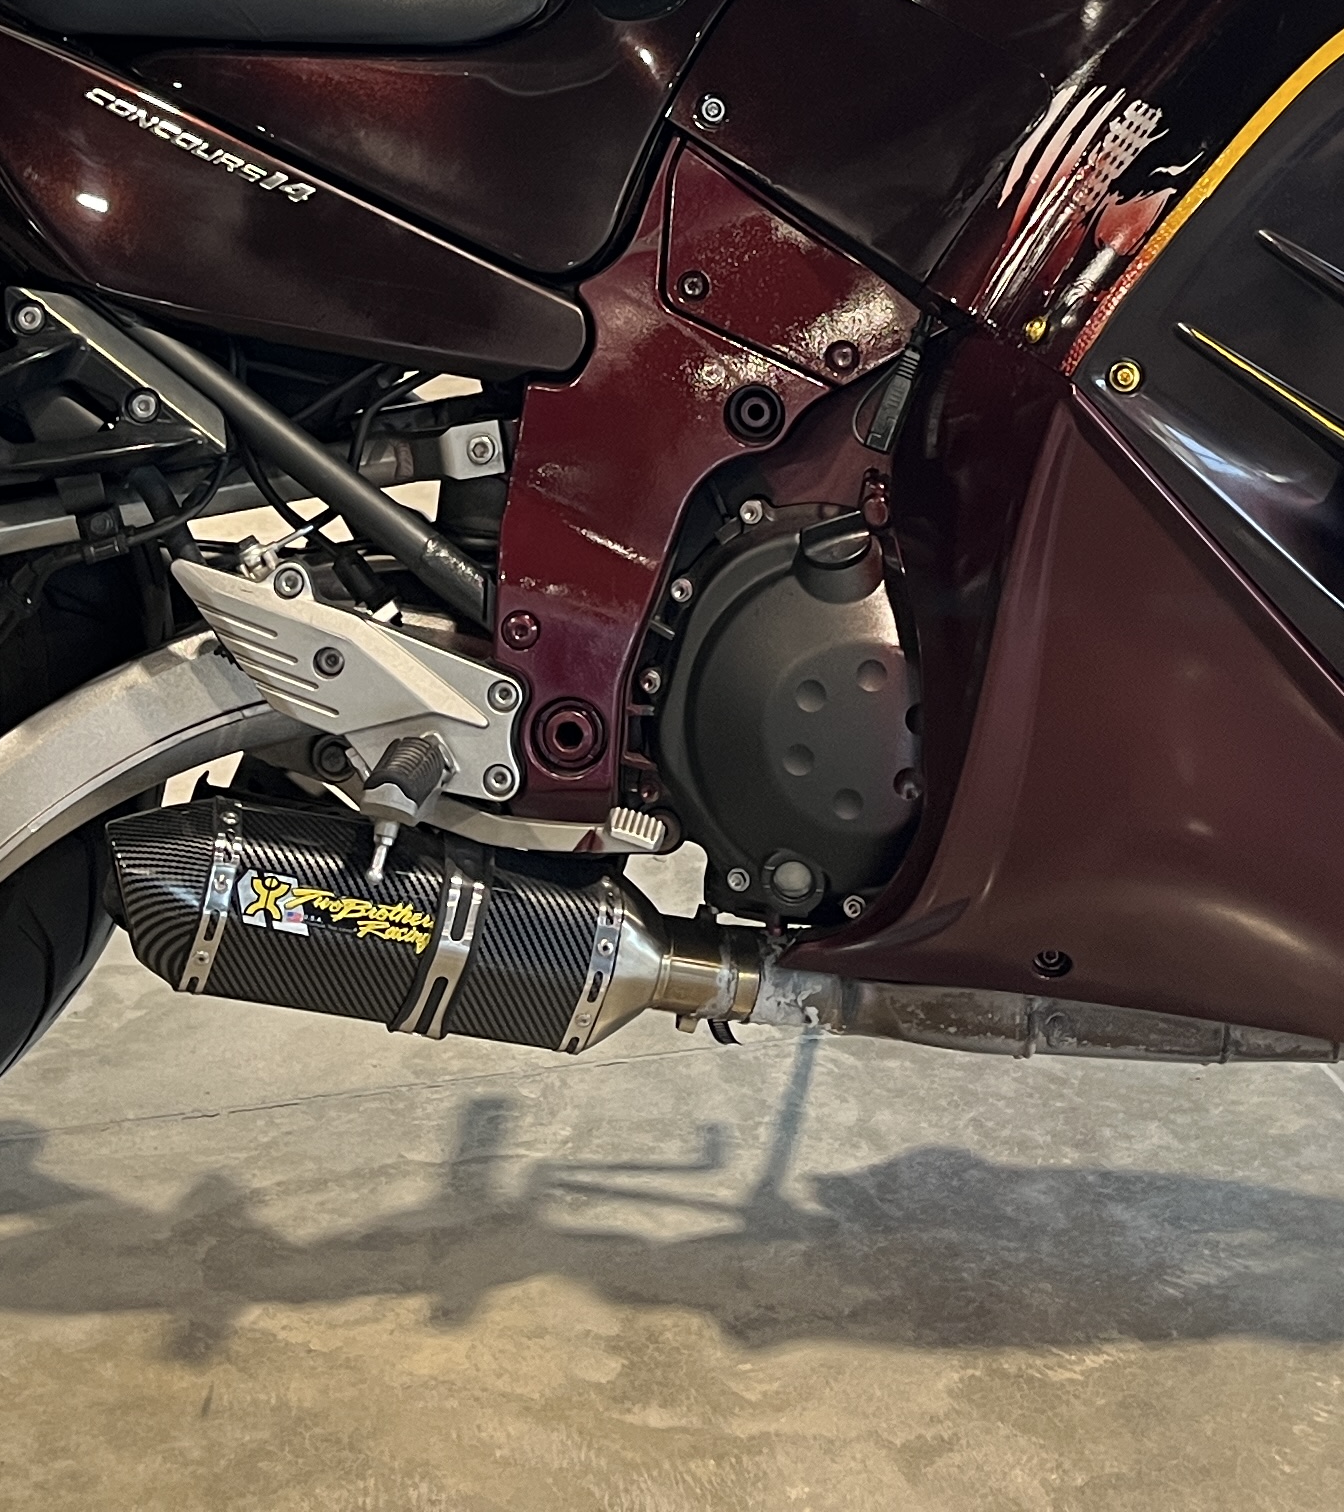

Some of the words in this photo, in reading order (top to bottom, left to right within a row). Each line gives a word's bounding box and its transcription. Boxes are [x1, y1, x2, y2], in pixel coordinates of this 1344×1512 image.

[284, 887, 344, 912] Two
[331, 896, 435, 926] Brother
[356, 920, 432, 955] Racing
